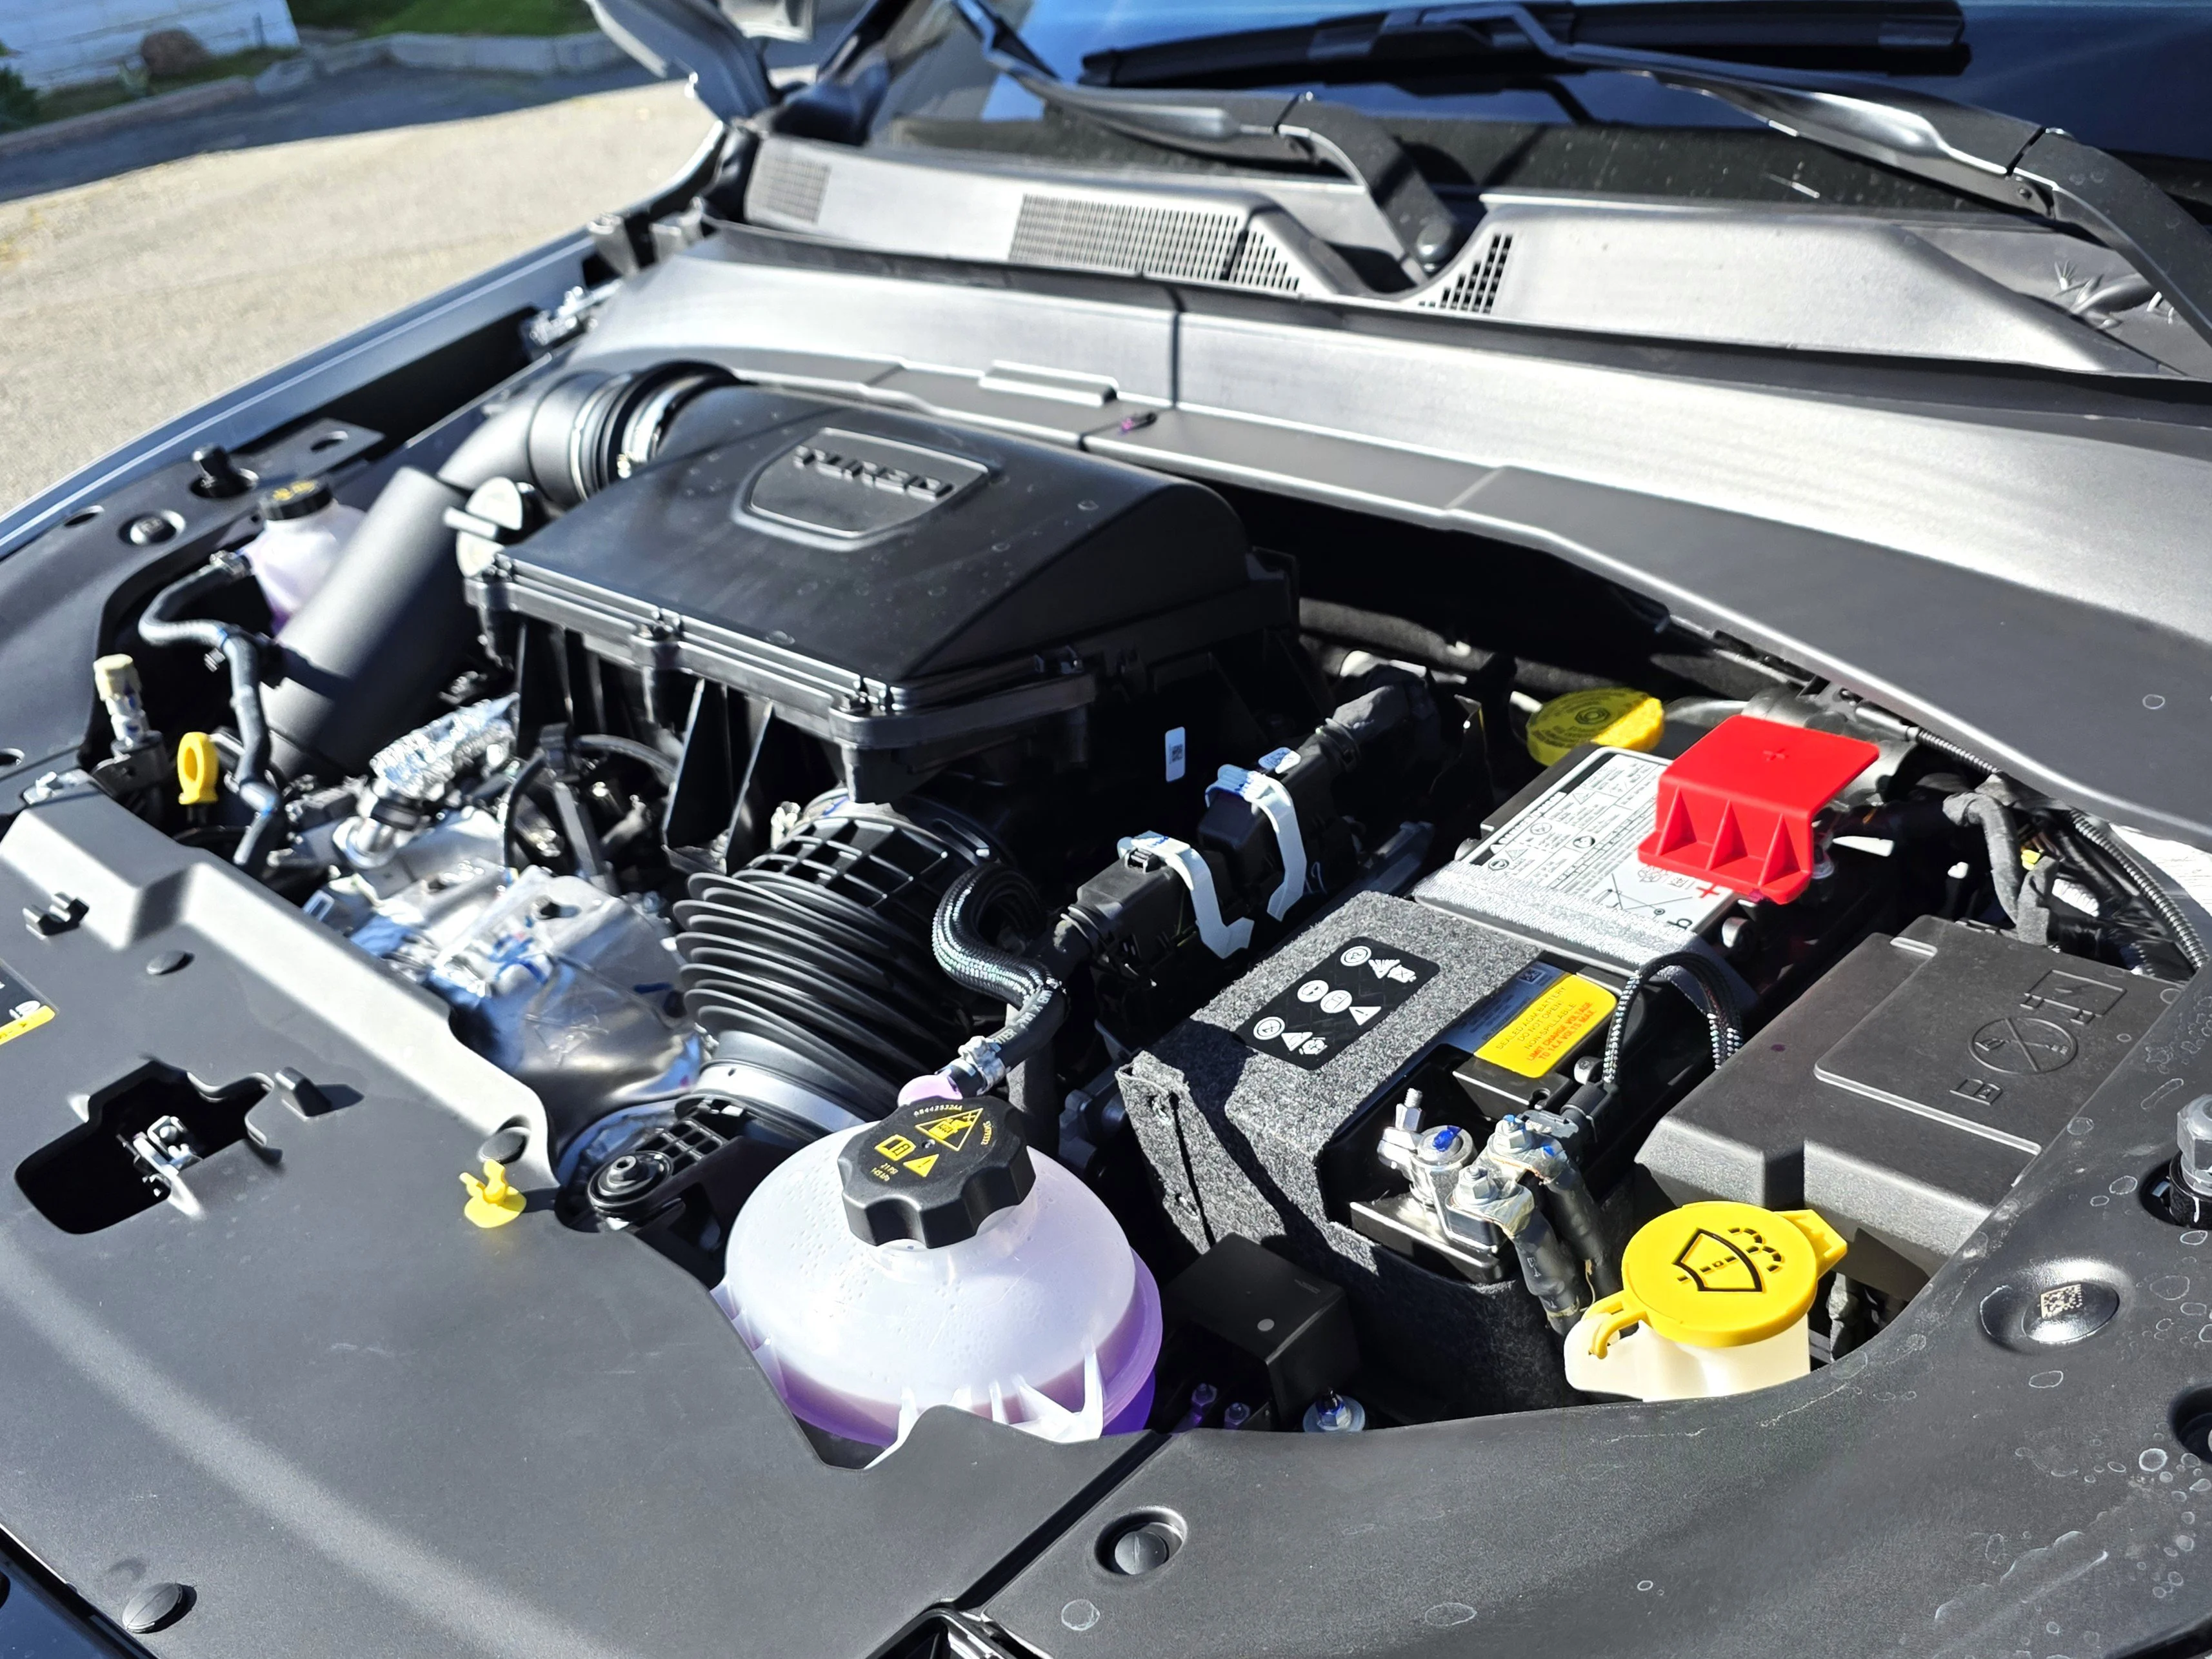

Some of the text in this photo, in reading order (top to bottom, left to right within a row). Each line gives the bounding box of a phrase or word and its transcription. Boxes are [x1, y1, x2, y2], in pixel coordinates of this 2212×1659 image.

[1496, 1026, 1523, 1049] SEALED
[1524, 1012, 1538, 1027] AGM
[1537, 987, 1566, 1012] BATTERY
[1517, 1029, 1529, 1041] DO
[1531, 1020, 1543, 1032] NOT
[1524, 1003, 1577, 1049] NON-SPILLABLE
[1527, 1001, 1593, 1061] LIMIT CHARGE VOLTAGE
[1539, 1051, 1550, 1060] TO
[1561, 1023, 1581, 1040] VOLTS
